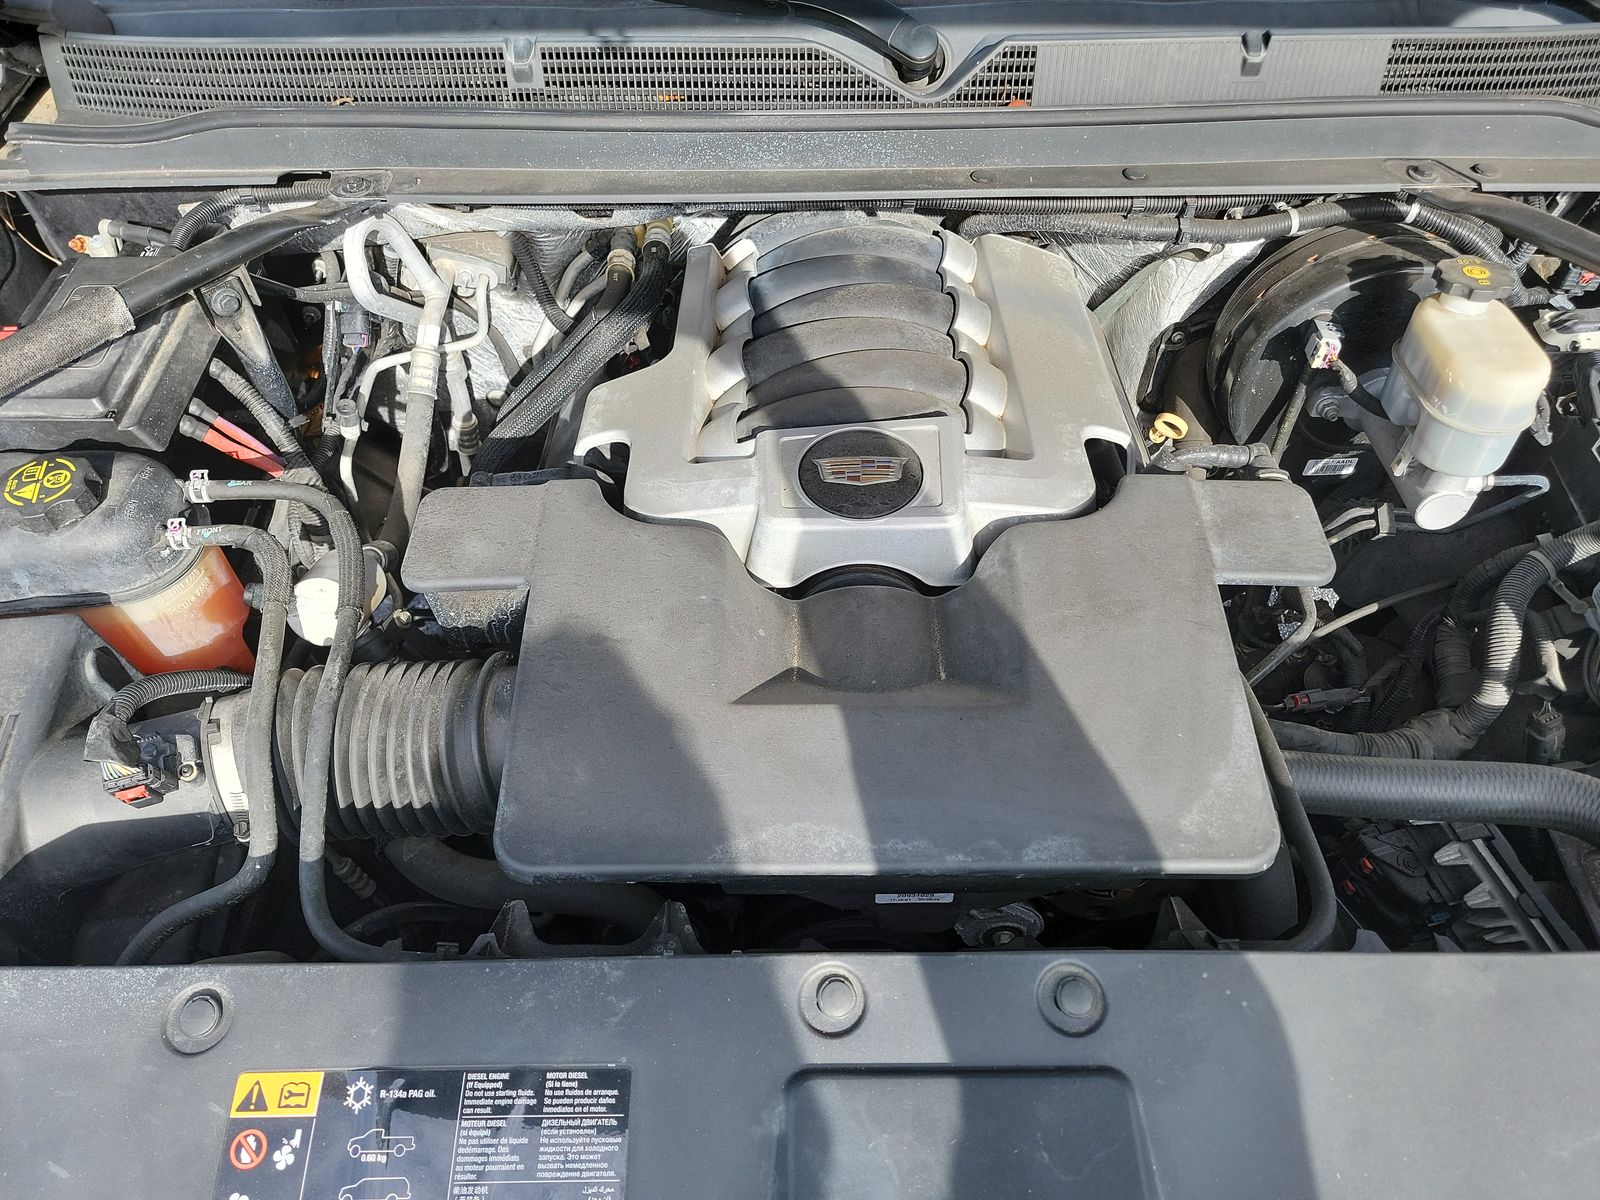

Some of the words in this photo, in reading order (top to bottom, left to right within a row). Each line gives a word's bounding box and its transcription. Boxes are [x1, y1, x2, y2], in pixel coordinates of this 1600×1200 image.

[196, 527, 222, 536] FRONT
[562, 1080, 578, 1088] tiene)
[380, 1089, 407, 1098] R-134a
[408, 1089, 424, 1098] PAG
[424, 1088, 436, 1098] oil.
[494, 1098, 513, 1106] engine
[574, 1097, 598, 1105] producir
[541, 1118, 580, 1126] ДИЗЕЛЬНЫЙ
[560, 1128, 596, 1136] установлен)
[508, 1137, 528, 1145] liquide
[376, 1154, 387, 1163] kg
[485, 1163, 516, 1172] pourraient
